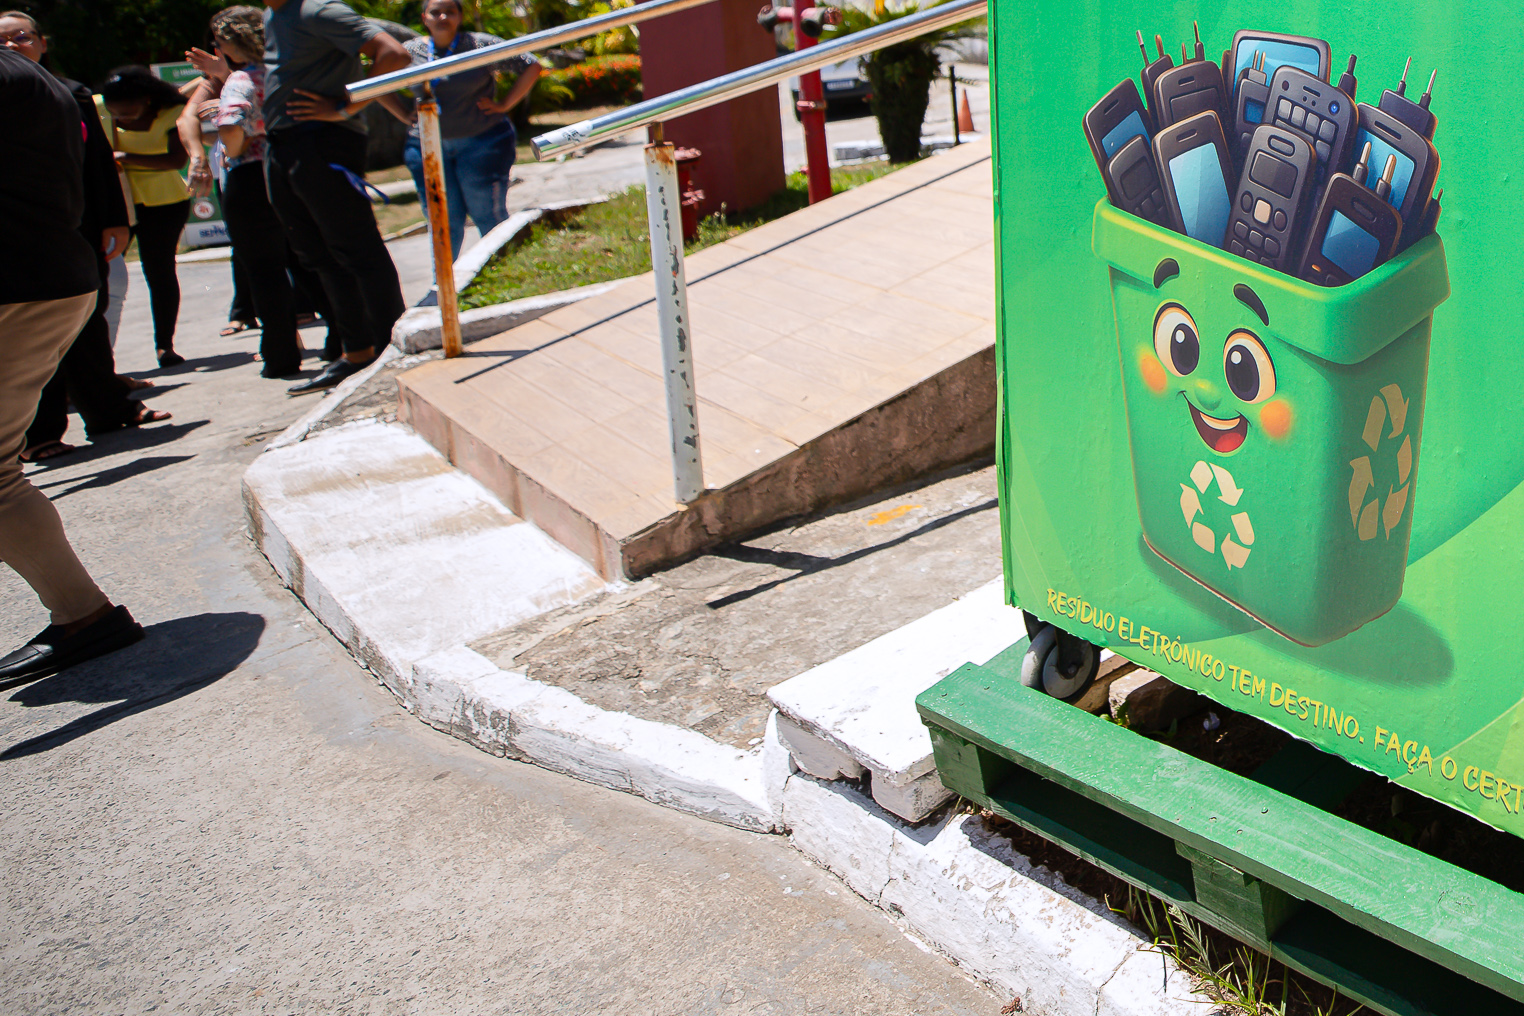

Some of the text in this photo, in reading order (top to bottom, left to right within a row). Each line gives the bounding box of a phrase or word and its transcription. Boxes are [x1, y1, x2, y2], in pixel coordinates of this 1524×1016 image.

[1047, 588, 1116, 633] RESÍDUO
[1118, 617, 1226, 682] ELETRÔNICO
[1228, 665, 1266, 704] TEM
[1269, 682, 1365, 744] DESTINO.
[1374, 725, 1433, 777] FAÇA
[1441, 756, 1458, 782] O
